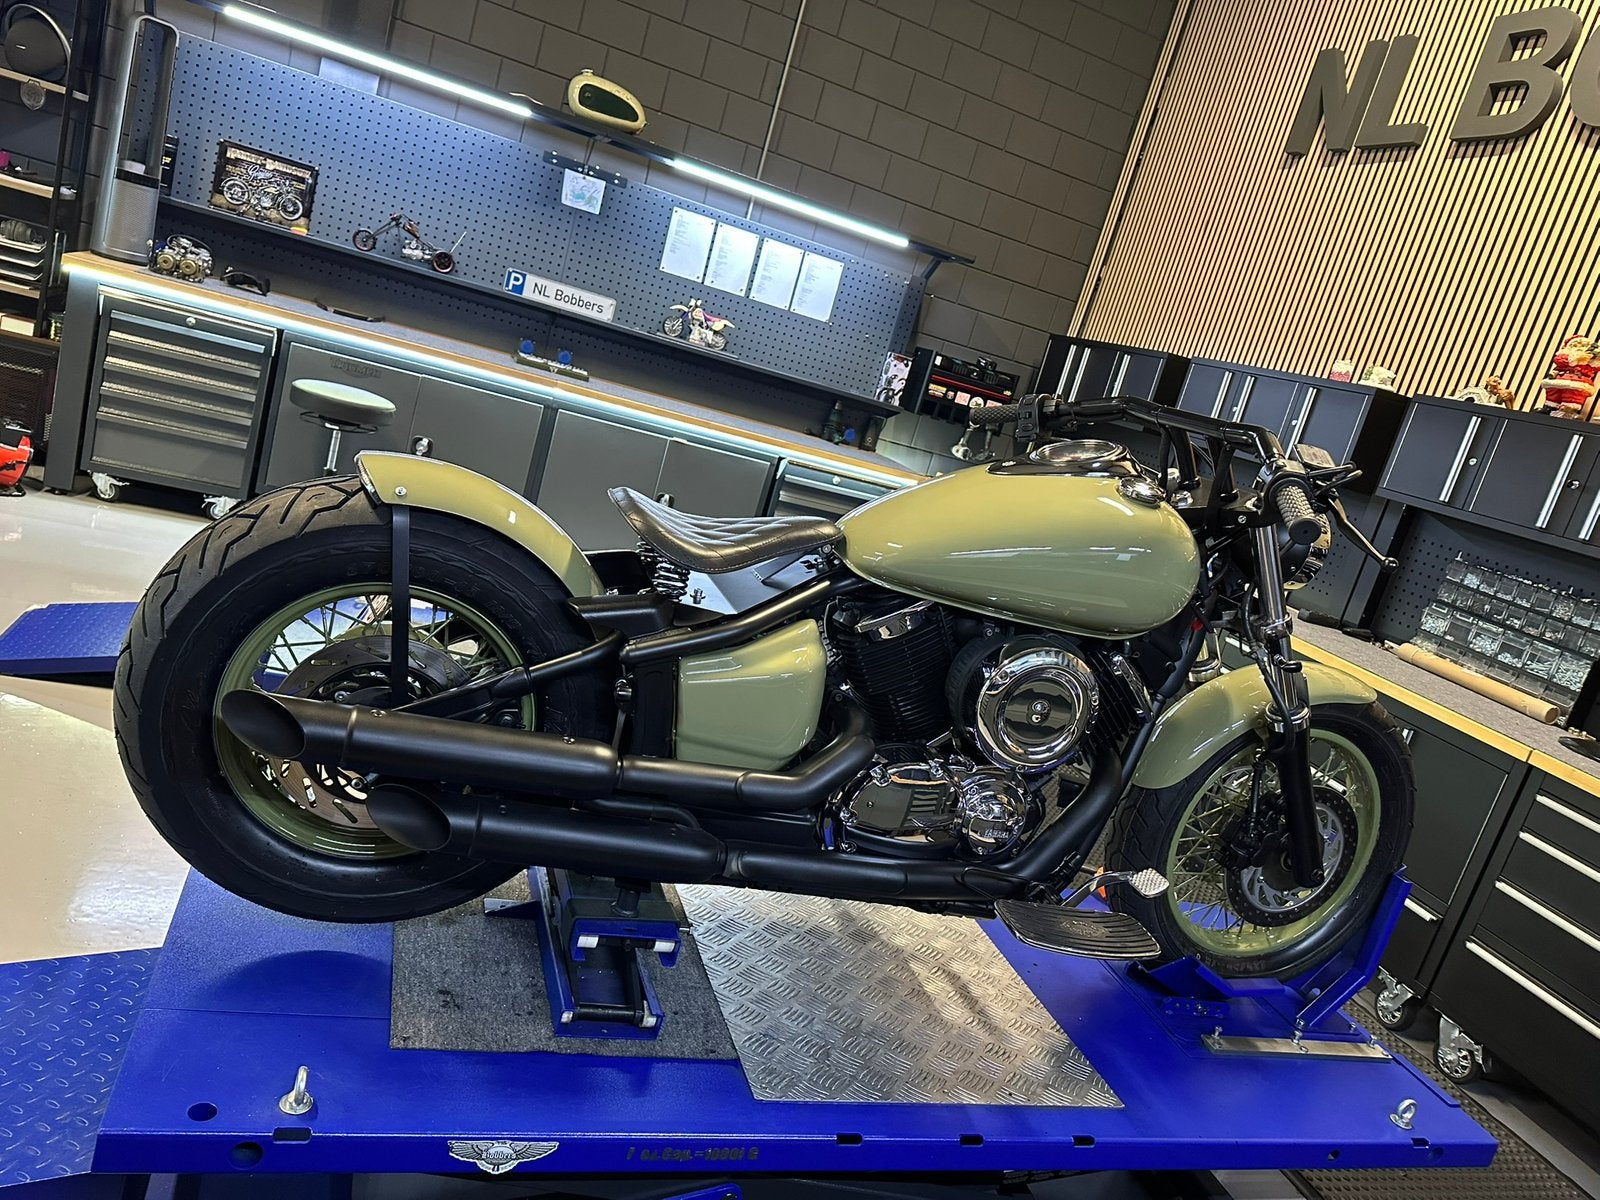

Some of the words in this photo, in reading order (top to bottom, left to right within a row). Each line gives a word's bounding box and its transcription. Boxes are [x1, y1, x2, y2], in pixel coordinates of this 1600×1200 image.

[1286, 33, 1429, 159] NL
[1450, 5, 1600, 143] B
[508, 272, 524, 291] P
[532, 282, 550, 298] NL
[554, 288, 604, 314] Bobbers
